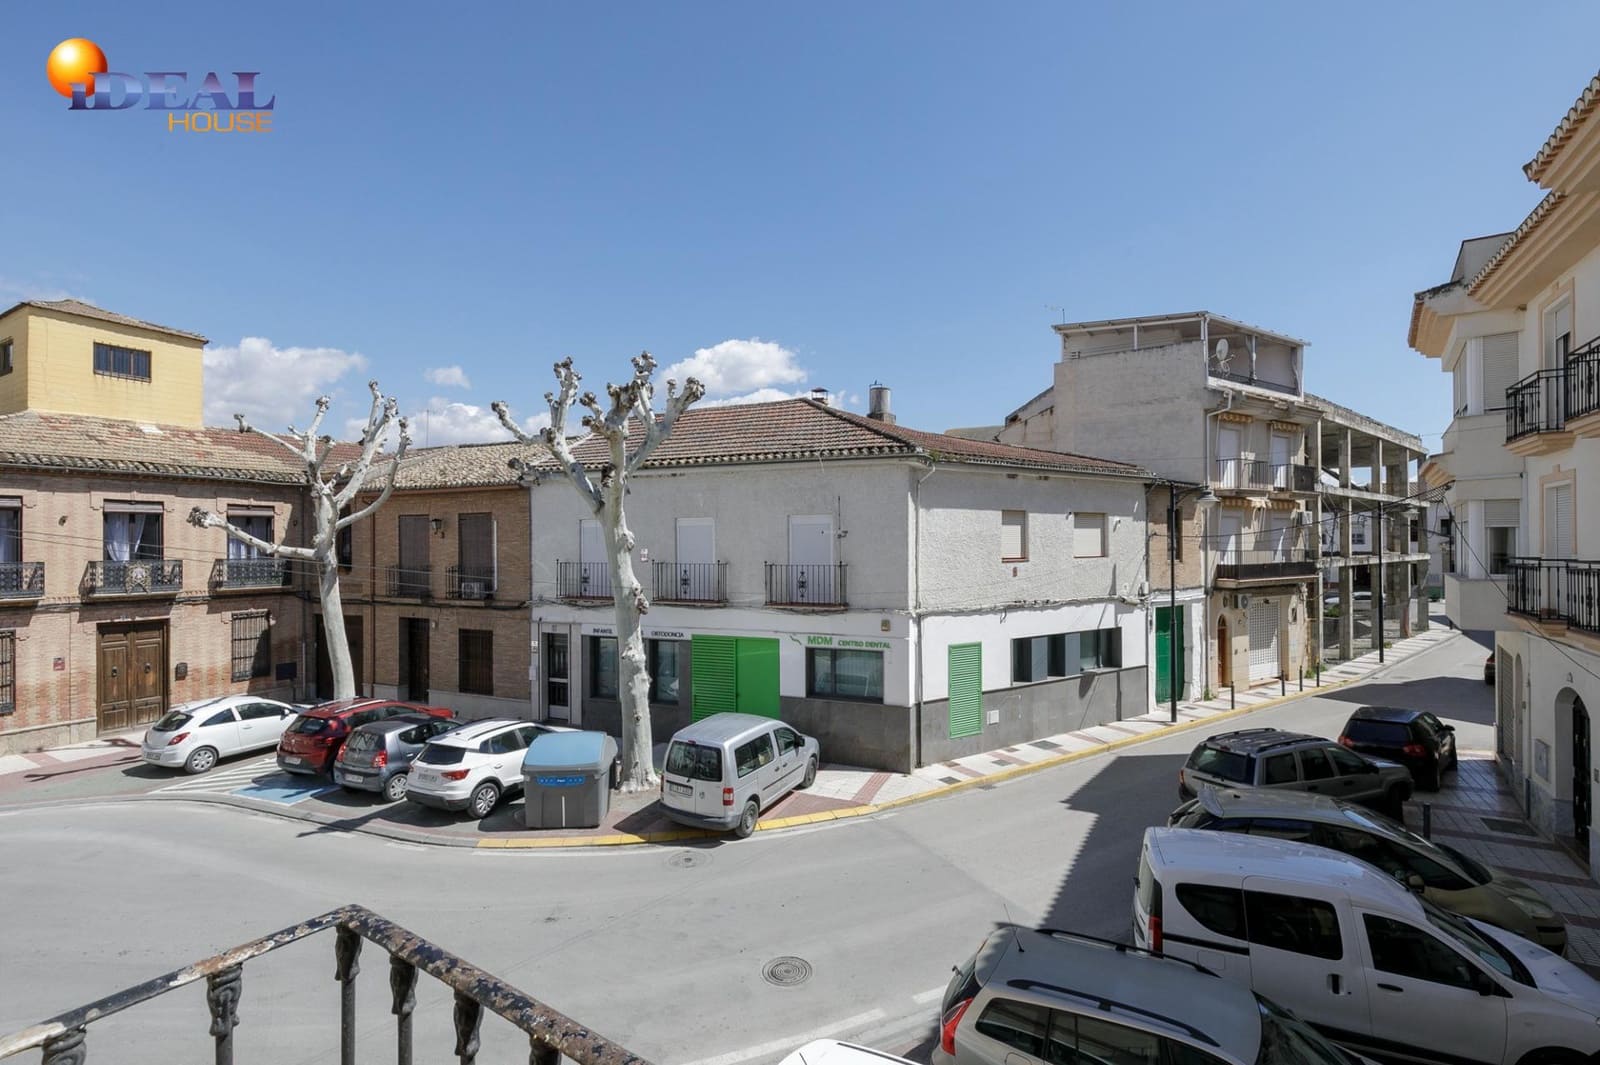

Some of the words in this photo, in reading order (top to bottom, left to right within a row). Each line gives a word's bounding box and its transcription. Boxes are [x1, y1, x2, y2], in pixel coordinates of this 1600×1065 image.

[651, 630, 685, 638] ORTODONCIA
[807, 635, 833, 645] MDM
[838, 639, 864, 647] CENTRO
[865, 641, 891, 649] DENTAL
